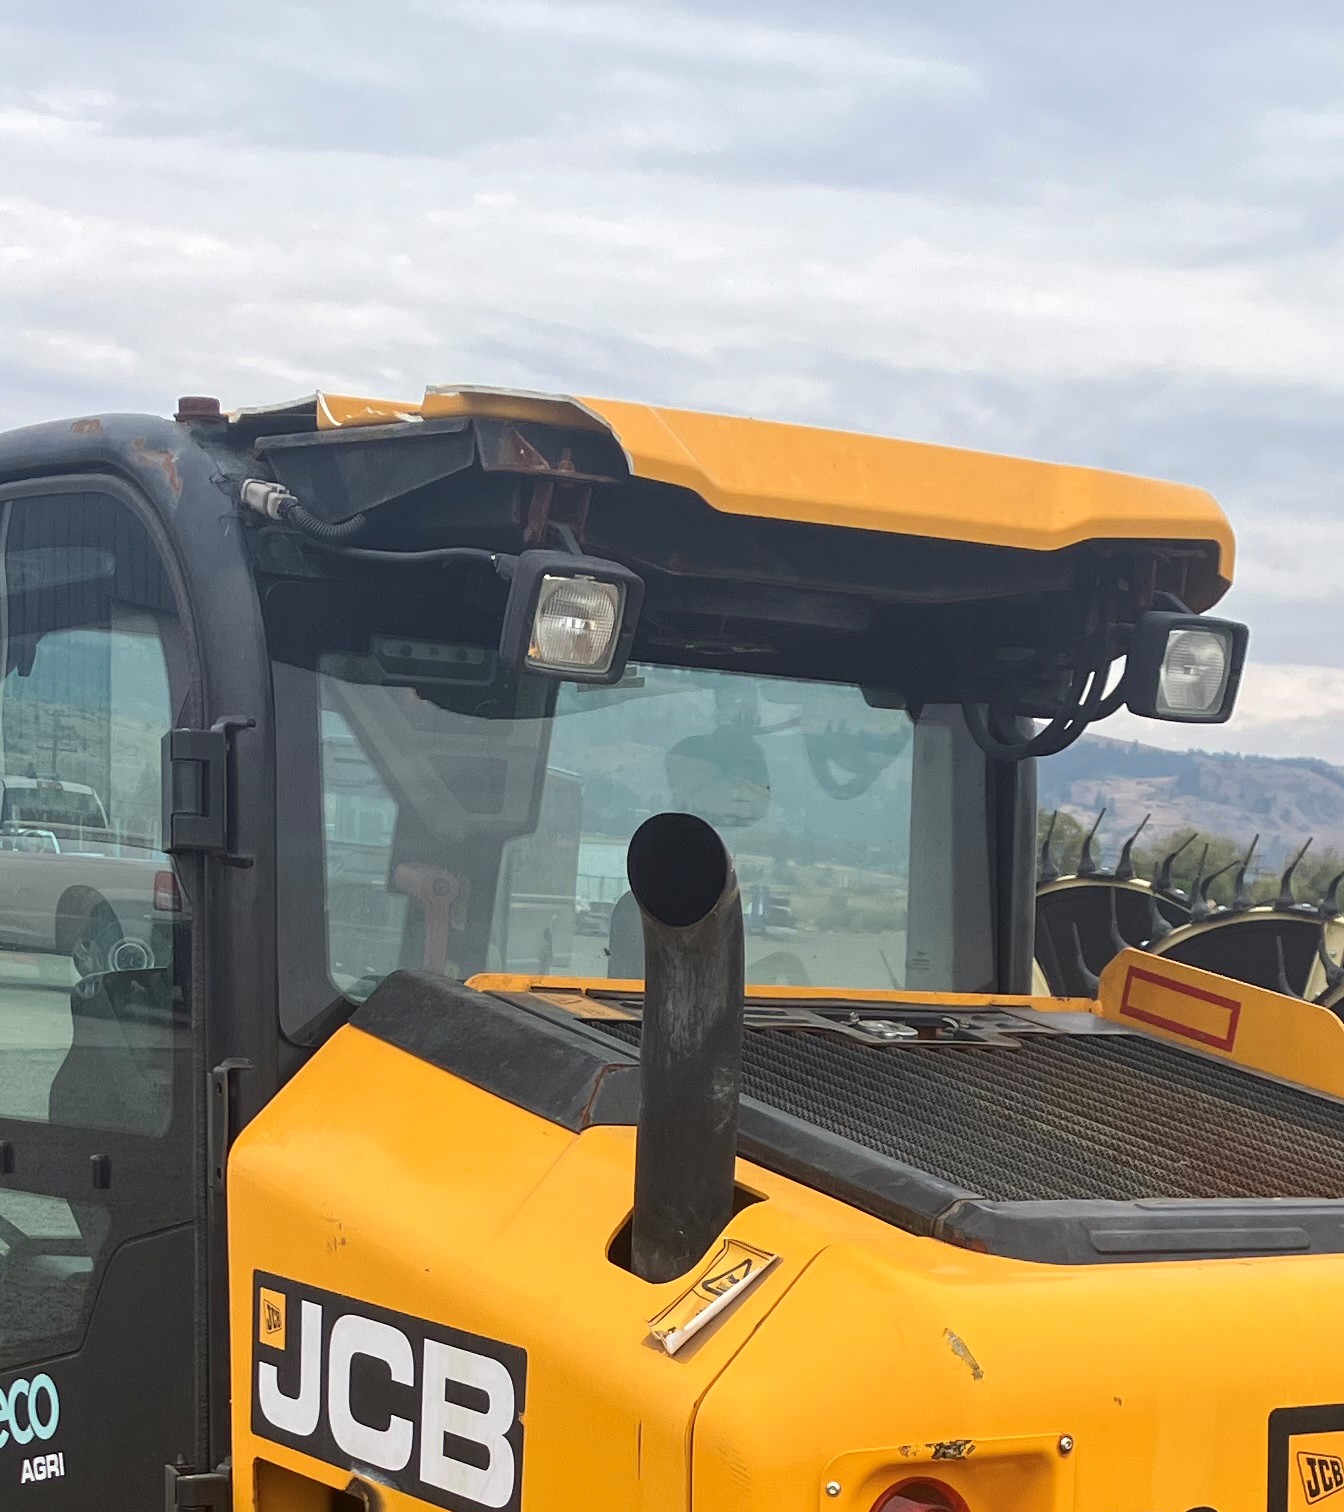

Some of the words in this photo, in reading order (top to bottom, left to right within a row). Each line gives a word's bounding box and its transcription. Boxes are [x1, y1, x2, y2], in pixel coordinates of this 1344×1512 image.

[259, 1299, 516, 1509] JCB
[20, 1452, 66, 1484] AGRI
[1304, 1457, 1344, 1498] JCB
